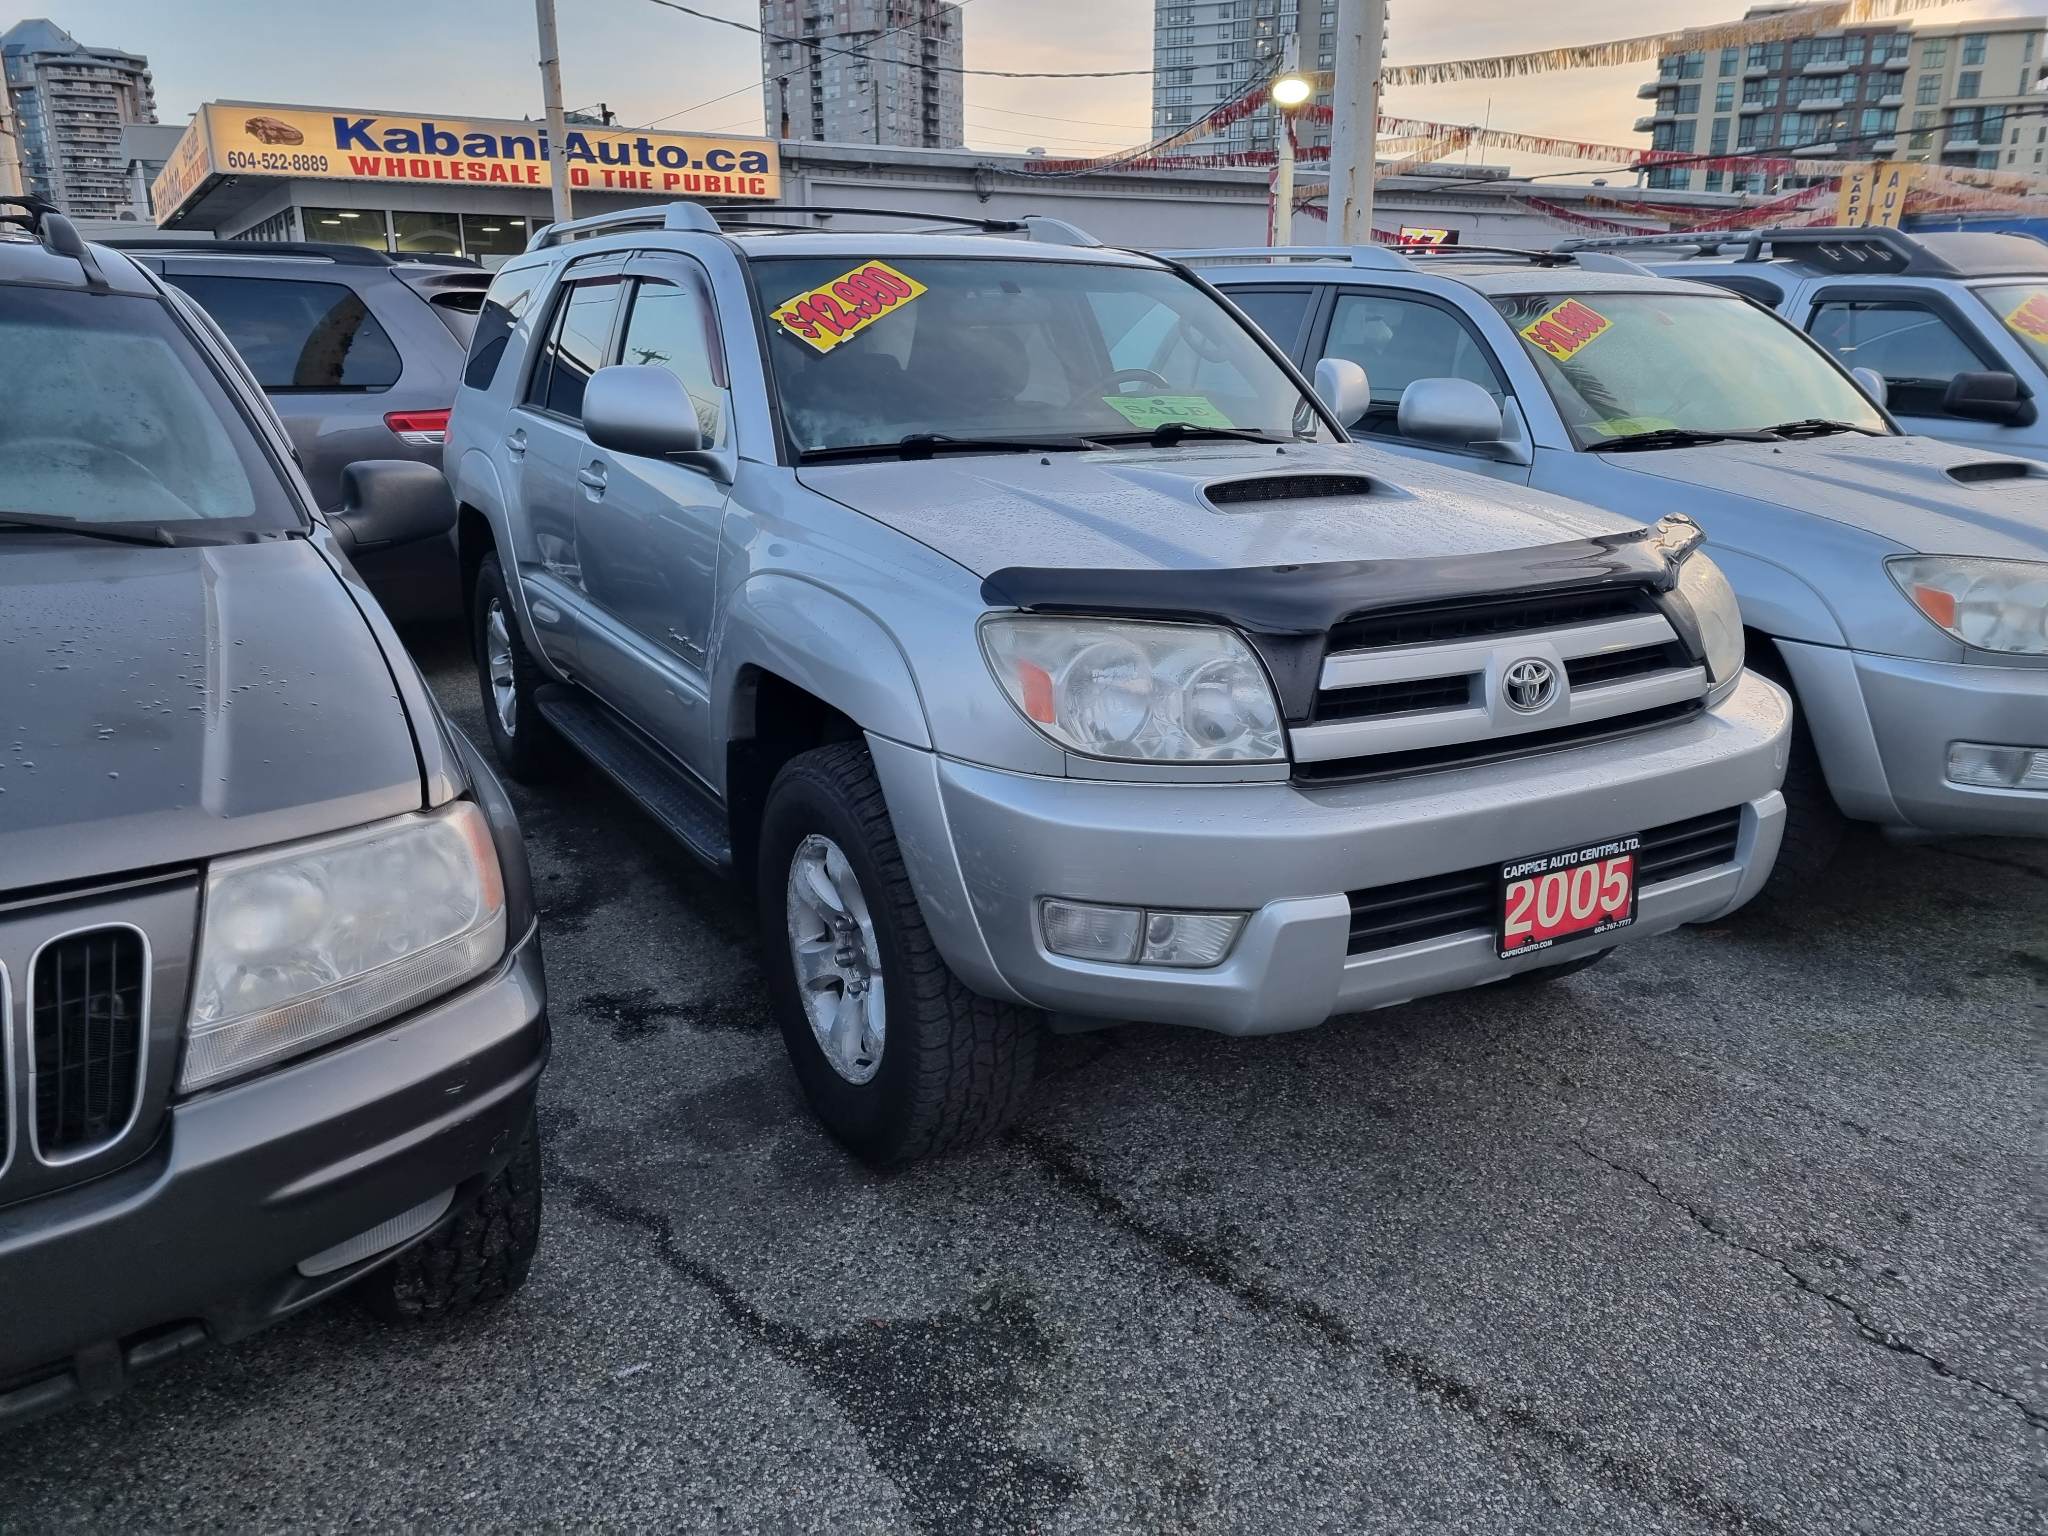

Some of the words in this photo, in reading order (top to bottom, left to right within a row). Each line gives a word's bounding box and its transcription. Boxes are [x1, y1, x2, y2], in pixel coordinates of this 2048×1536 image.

[348, 155, 541, 184] WHOLESALE
[600, 168, 653, 189] THE
[663, 172, 766, 195] PUBLIC
[781, 266, 912, 338] $12,990
[1123, 405, 1210, 417] SALE
[1549, 852, 1578, 869] AUTO
[1620, 838, 1641, 853] LTD.
[1505, 855, 1630, 937] 2005
[1593, 918, 1632, 935] 604-767-7777
[1500, 940, 1553, 959] CAPRICEAUTO.COM
